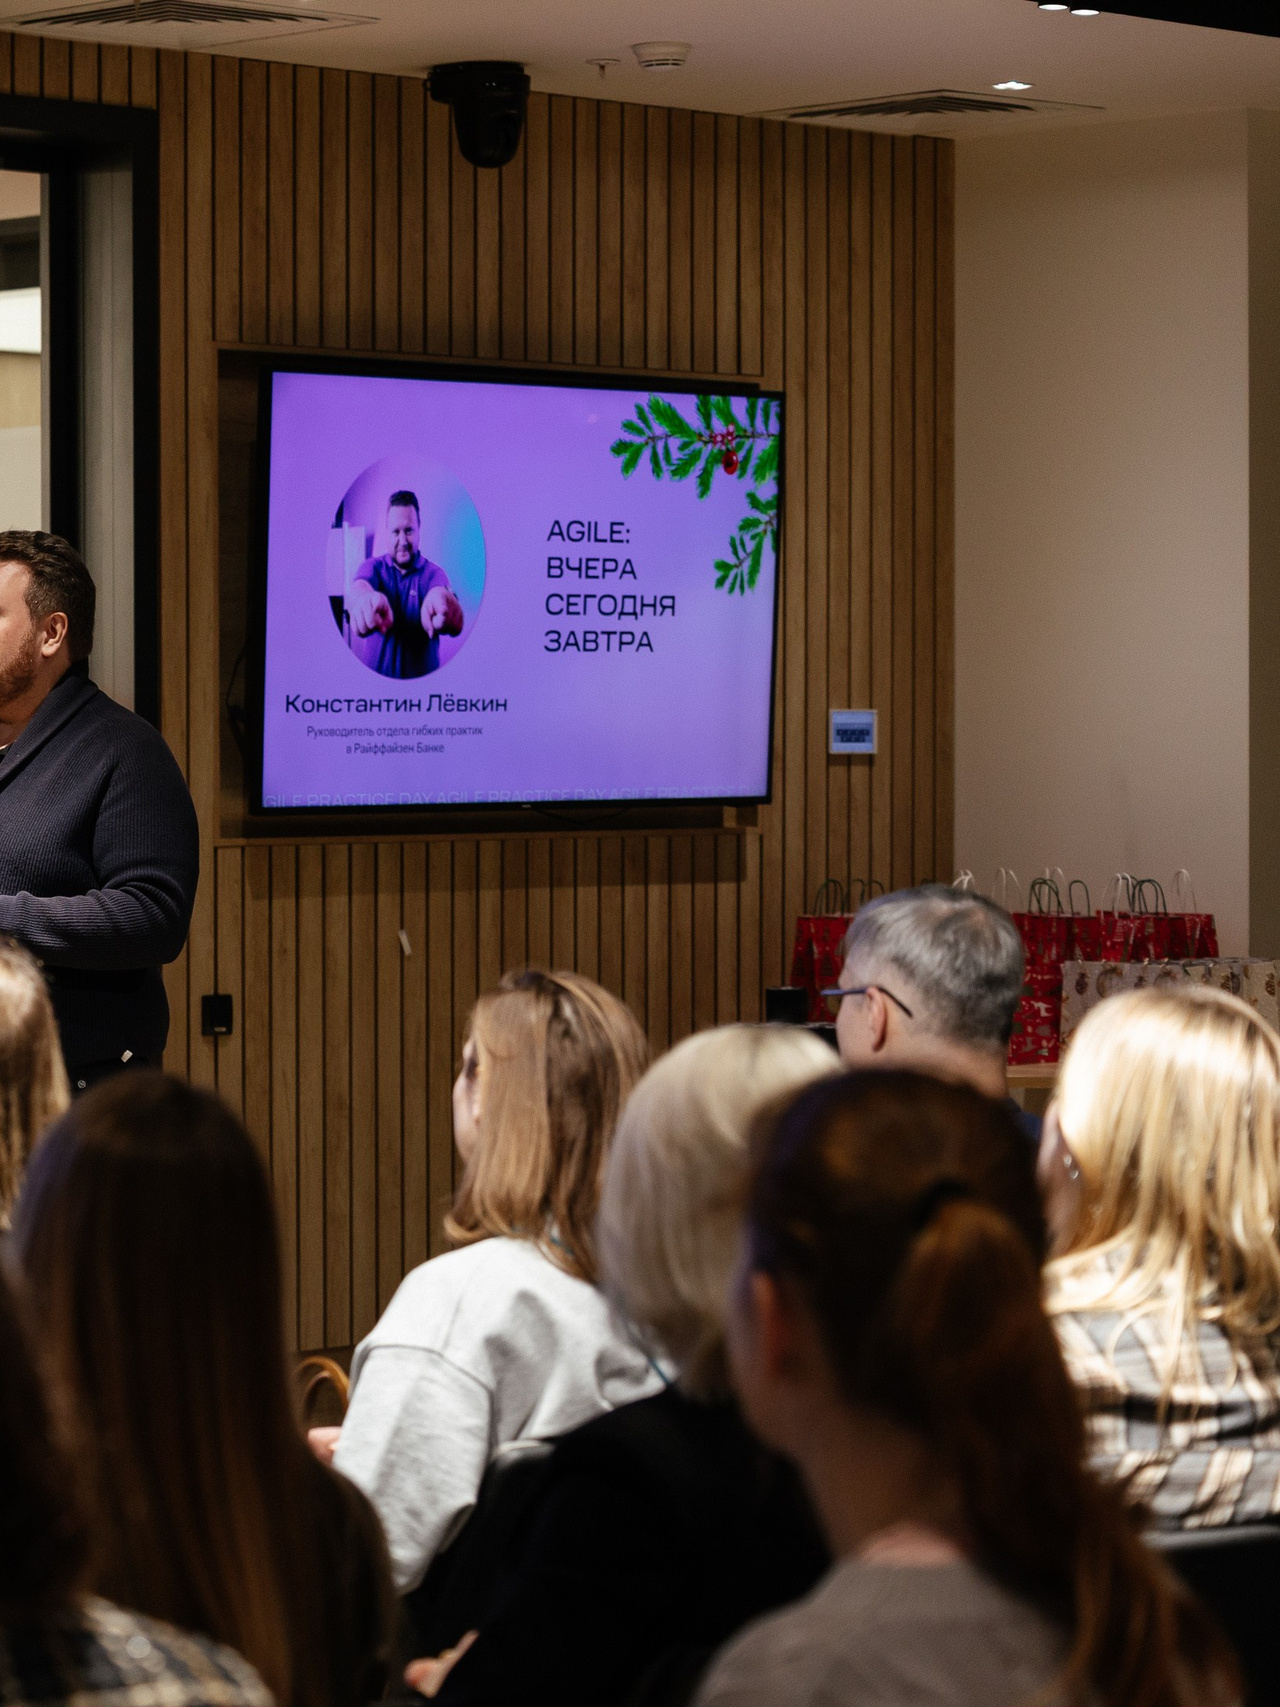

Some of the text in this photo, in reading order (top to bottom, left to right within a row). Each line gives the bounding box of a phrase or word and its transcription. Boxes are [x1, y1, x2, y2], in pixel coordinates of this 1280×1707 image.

[546, 519, 630, 544] AGILE:
[546, 556, 637, 580] ВЧЕРА
[545, 593, 676, 620] СЕГОДНЯ
[543, 629, 654, 653] ЗАВТРА
[285, 693, 508, 713] Константин Лёвкин
[306, 724, 483, 739] Руководитель отдела гибких практик
[346, 742, 445, 755] в Райффайзен Банке
